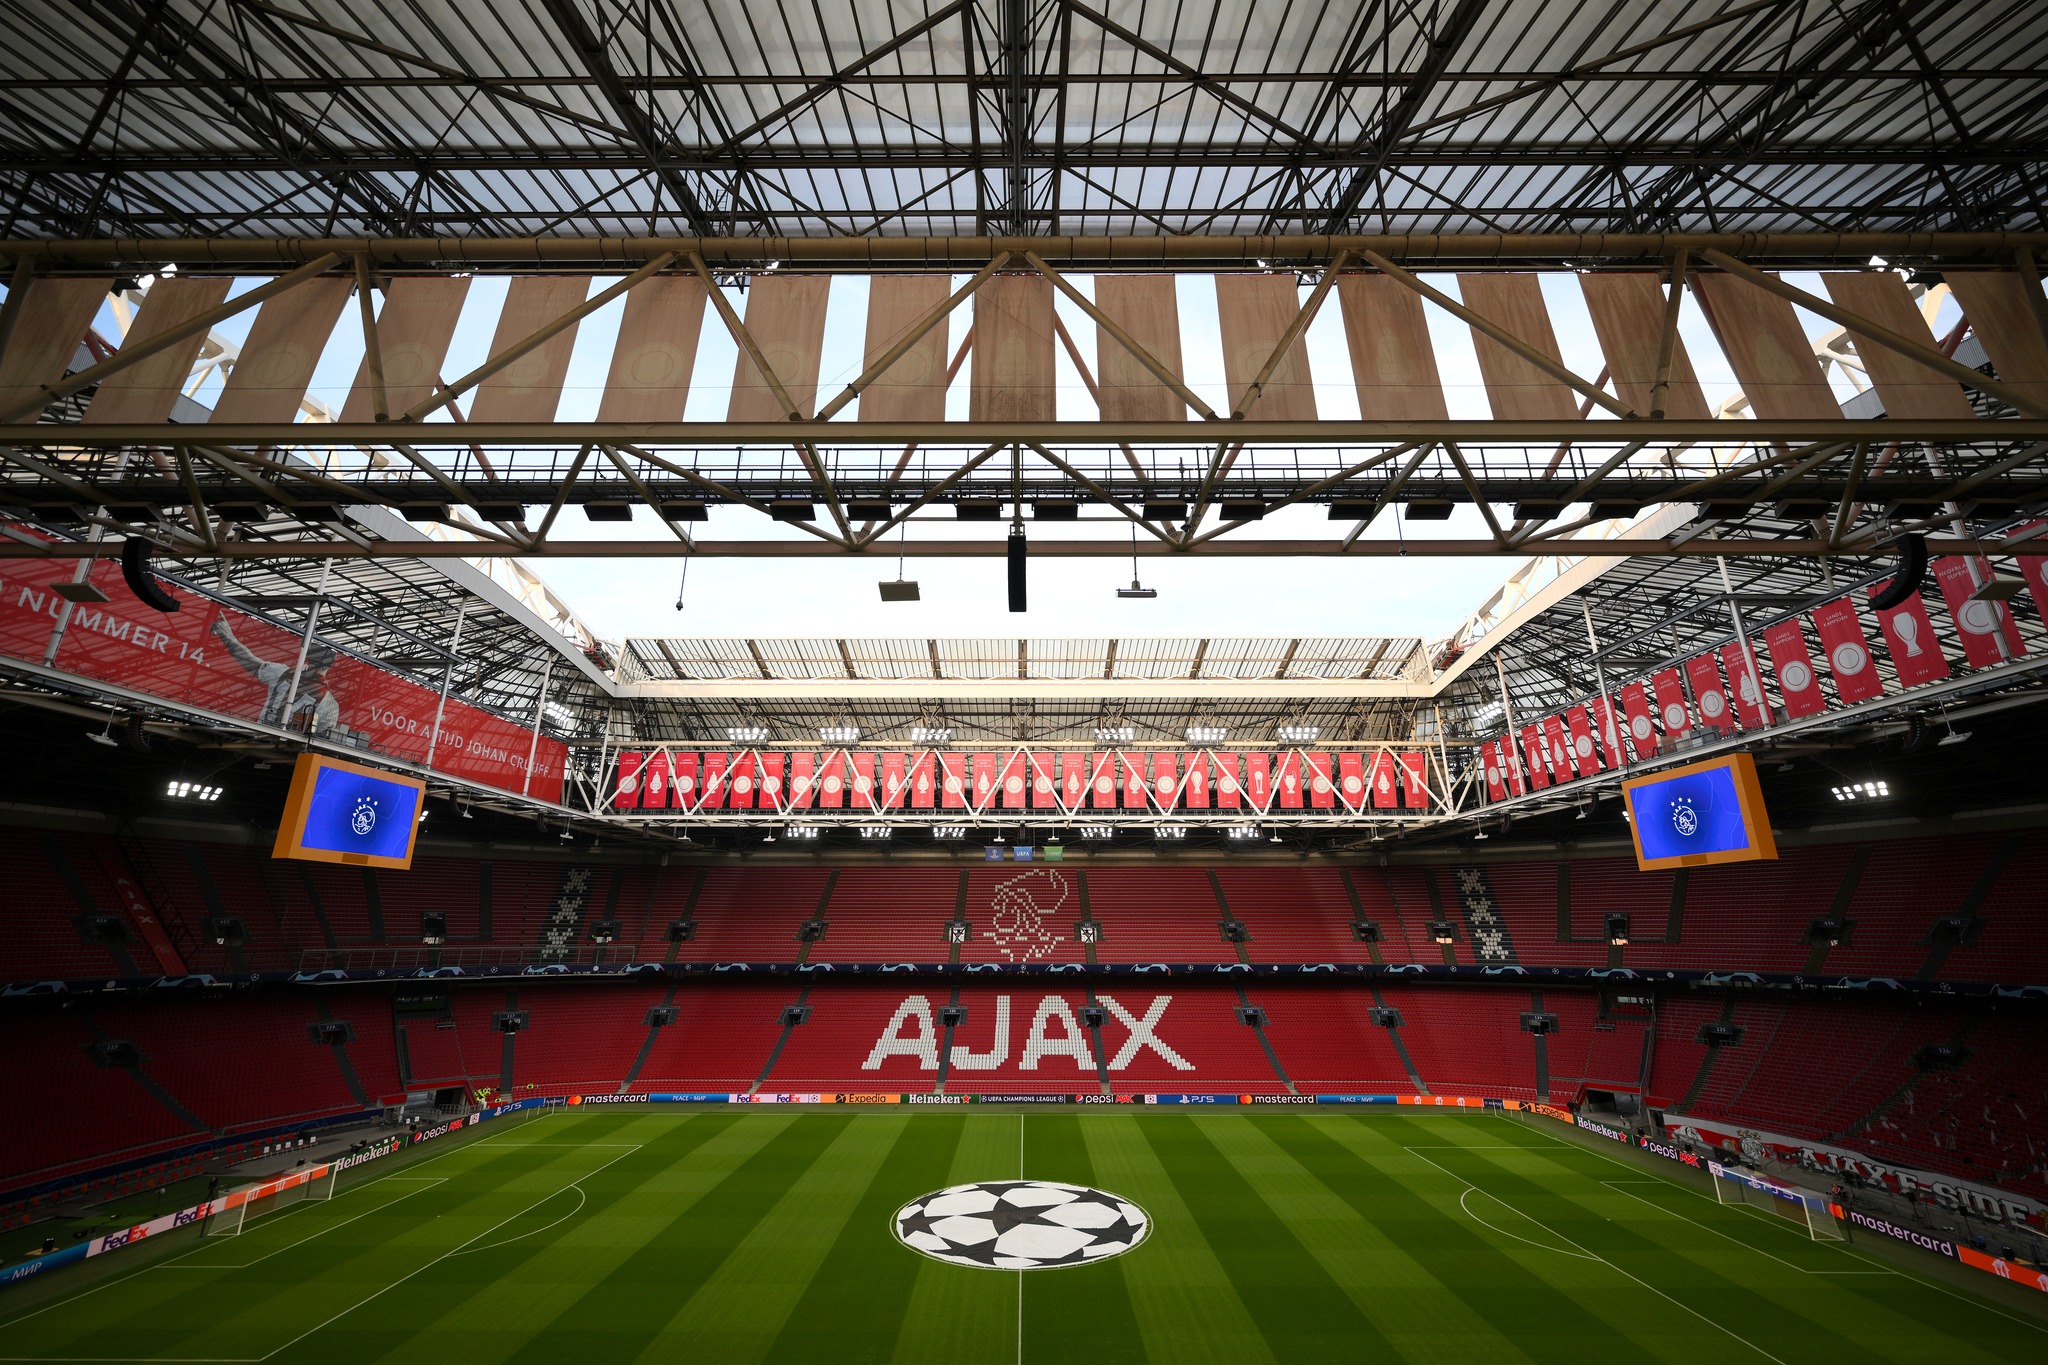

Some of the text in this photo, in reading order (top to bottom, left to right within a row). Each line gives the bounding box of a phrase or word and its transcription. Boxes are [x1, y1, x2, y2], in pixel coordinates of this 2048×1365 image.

[371, 706, 551, 778] VOOR ATIJD JOHAN CRUJFF.
[861, 995, 1196, 1070] AJAX
[502, 1101, 522, 1112] PS5
[584, 1094, 647, 1104] mastercard
[736, 1094, 760, 1103] FedEx
[776, 1094, 800, 1103] FedEx
[850, 1094, 886, 1103] Expedia
[908, 1094, 960, 1104] Heineken
[1086, 1095, 1134, 1104] pepsi MAX
[1255, 1095, 1314, 1104] mastercard
[1534, 1103, 1565, 1120] Expedia
[422, 1117, 465, 1142] pepsi MAX
[1577, 1116, 1619, 1140] Heineken
[335, 1144, 390, 1172] Heineken
[1650, 1141, 1700, 1168] pepsi MAX
[1799, 1146, 2030, 1223] AJAX F-SIDE
[172, 1202, 215, 1227] FedEx
[101, 1224, 151, 1251] FedEx
[1850, 1210, 1953, 1257] mastercard
[12, 1261, 42, 1280] МИР
